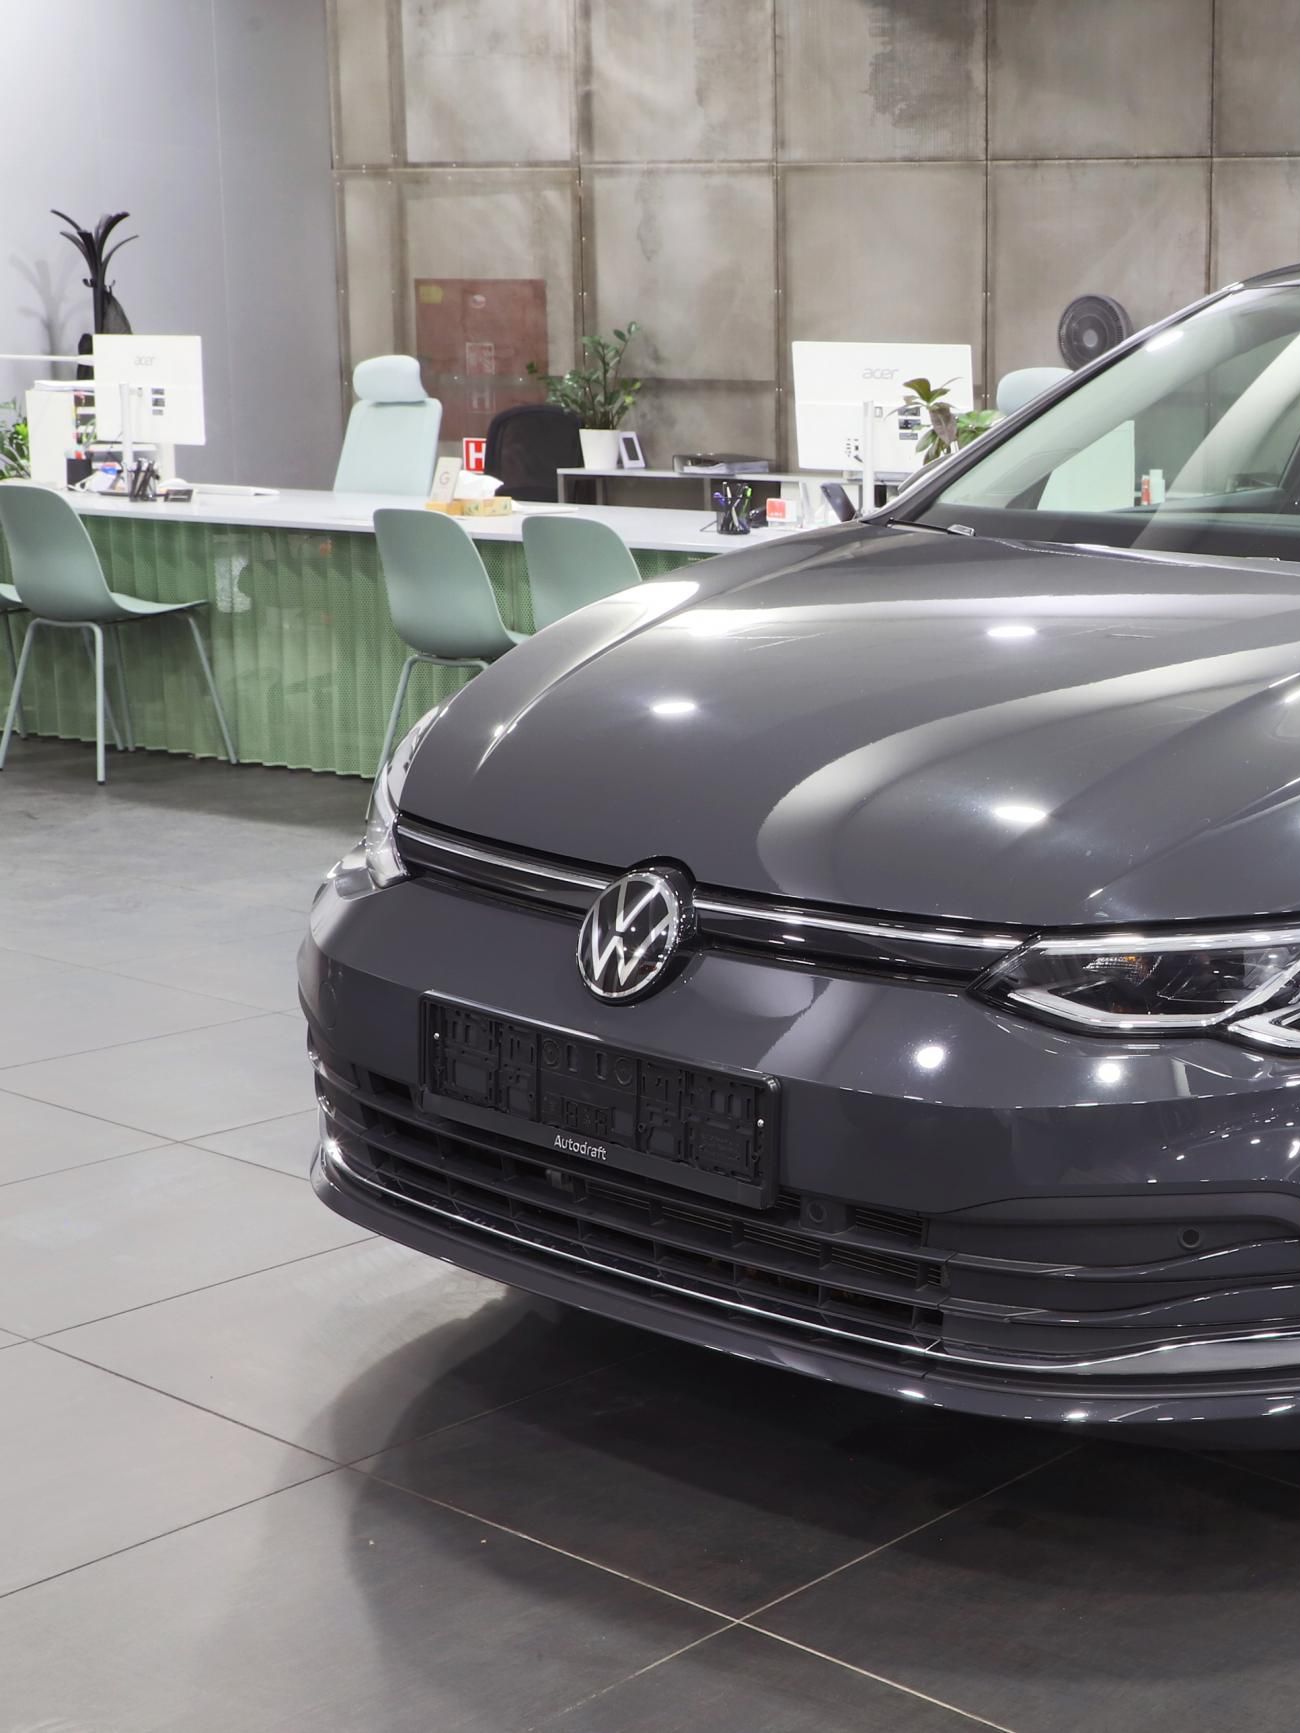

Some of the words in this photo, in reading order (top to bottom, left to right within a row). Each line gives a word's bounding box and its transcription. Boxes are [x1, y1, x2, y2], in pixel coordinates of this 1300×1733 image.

[861, 367, 900, 380] acer
[468, 442, 487, 470] H
[554, 1134, 607, 1160] Autodraft
